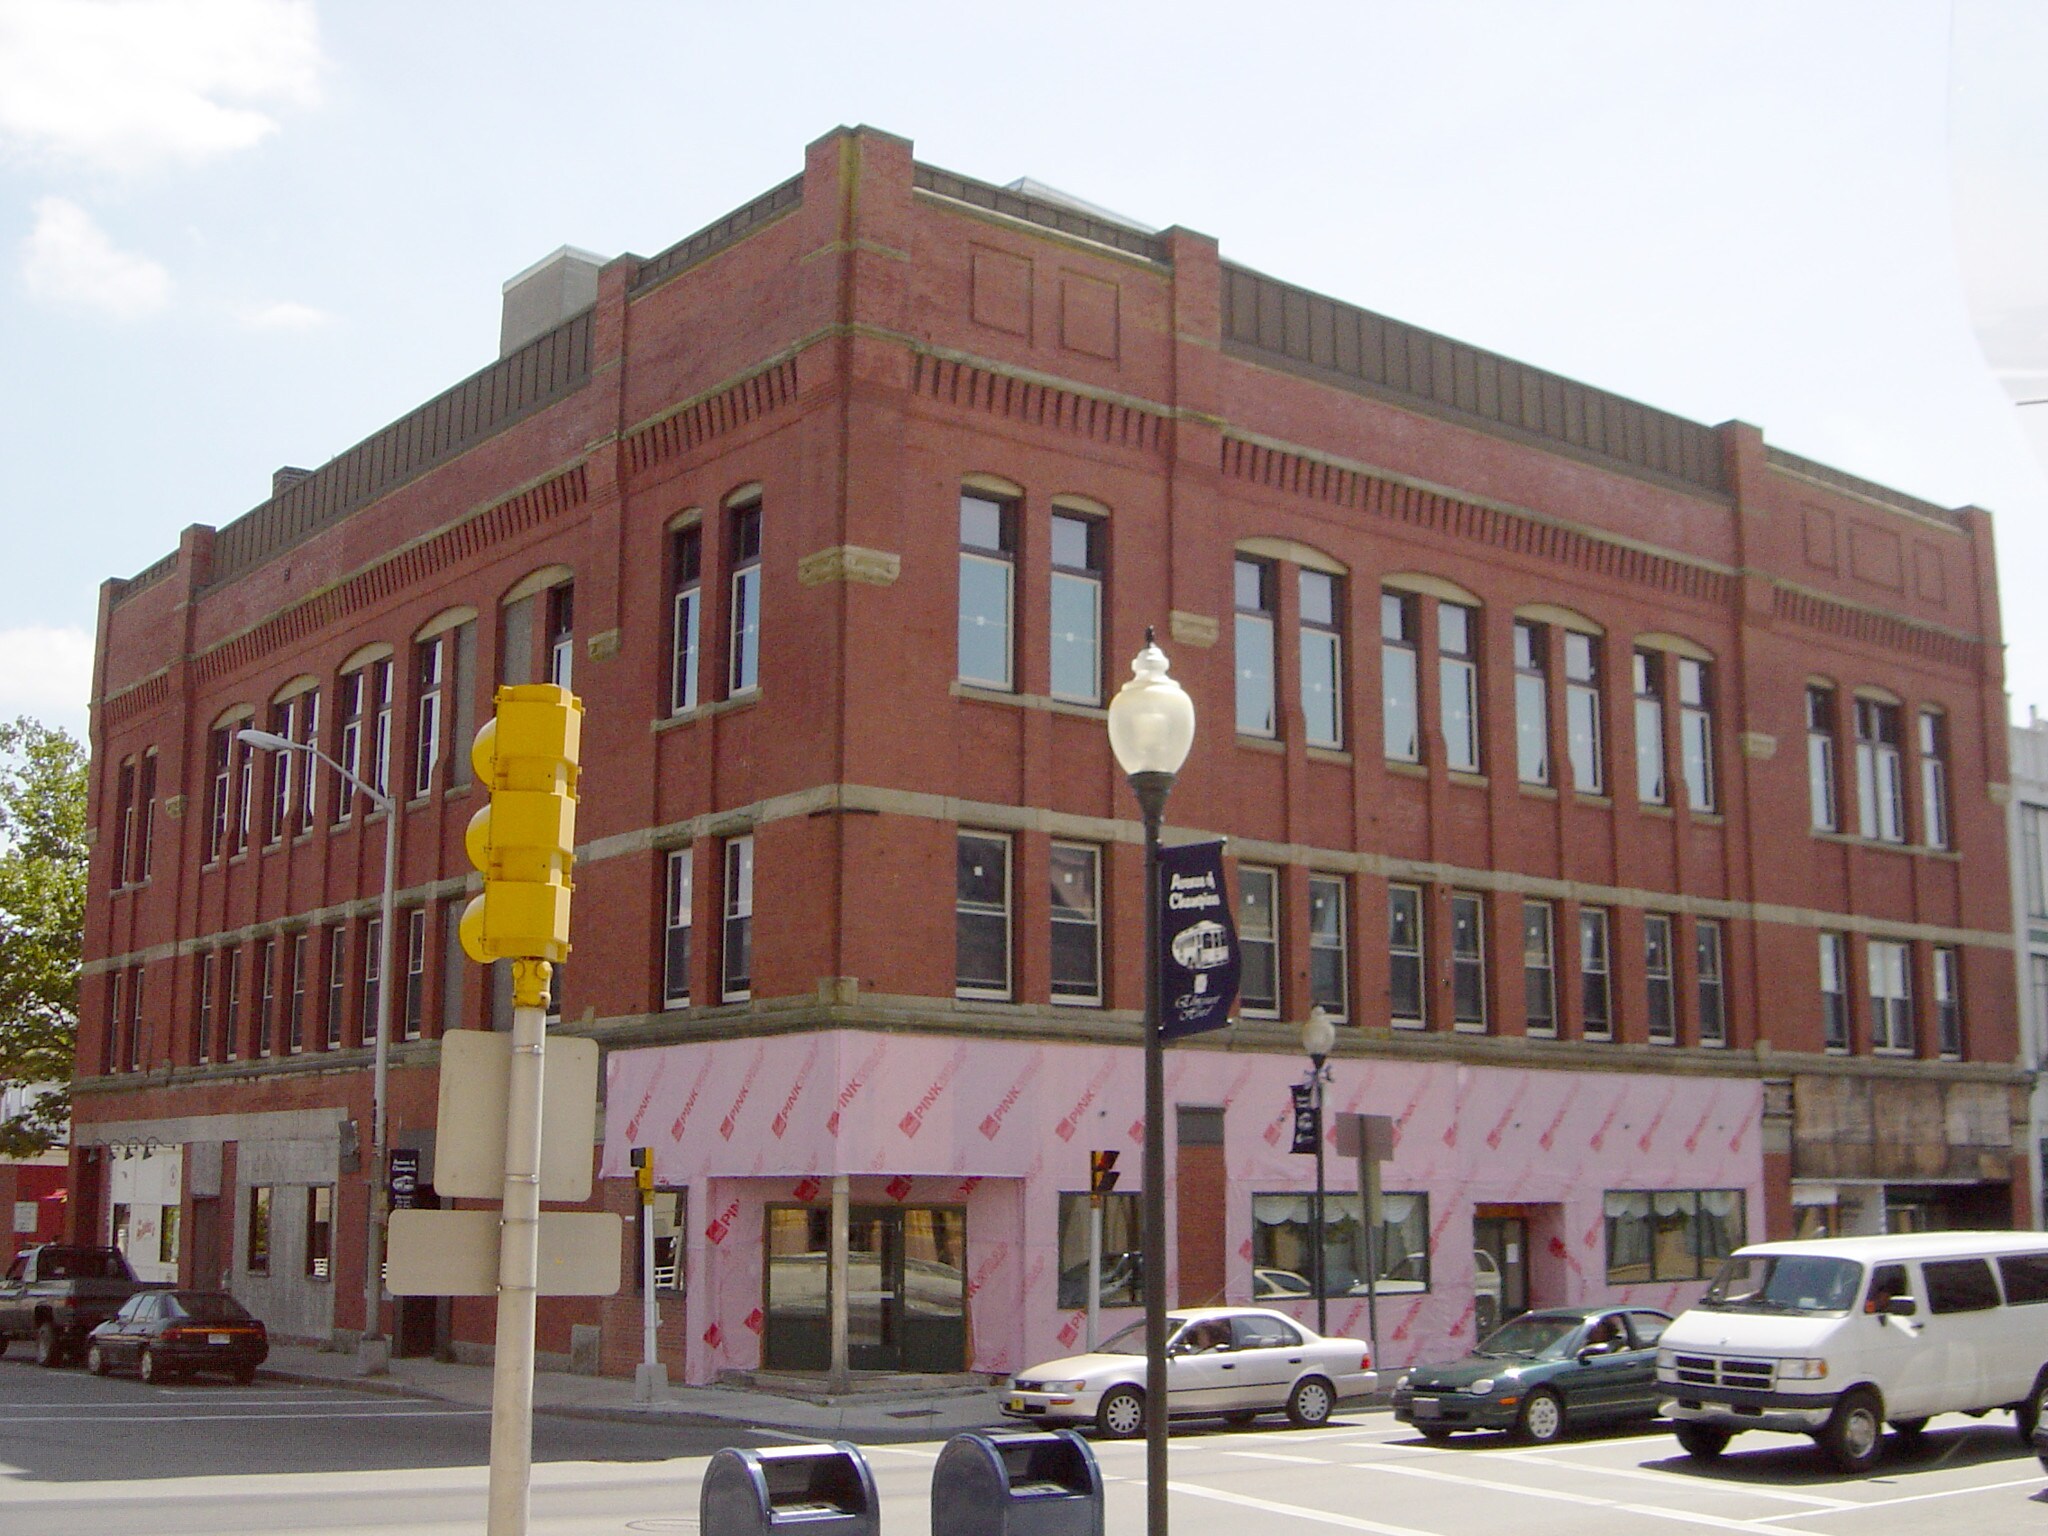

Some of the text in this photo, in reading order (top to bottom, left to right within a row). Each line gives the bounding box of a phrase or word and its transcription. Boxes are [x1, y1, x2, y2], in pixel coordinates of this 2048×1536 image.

[730, 1085, 749, 1122] PINK
[781, 1081, 802, 1121] PINK
[914, 1081, 943, 1120] PINK
[993, 1085, 1021, 1122] PINK
[1069, 1088, 1095, 1125] PINK
